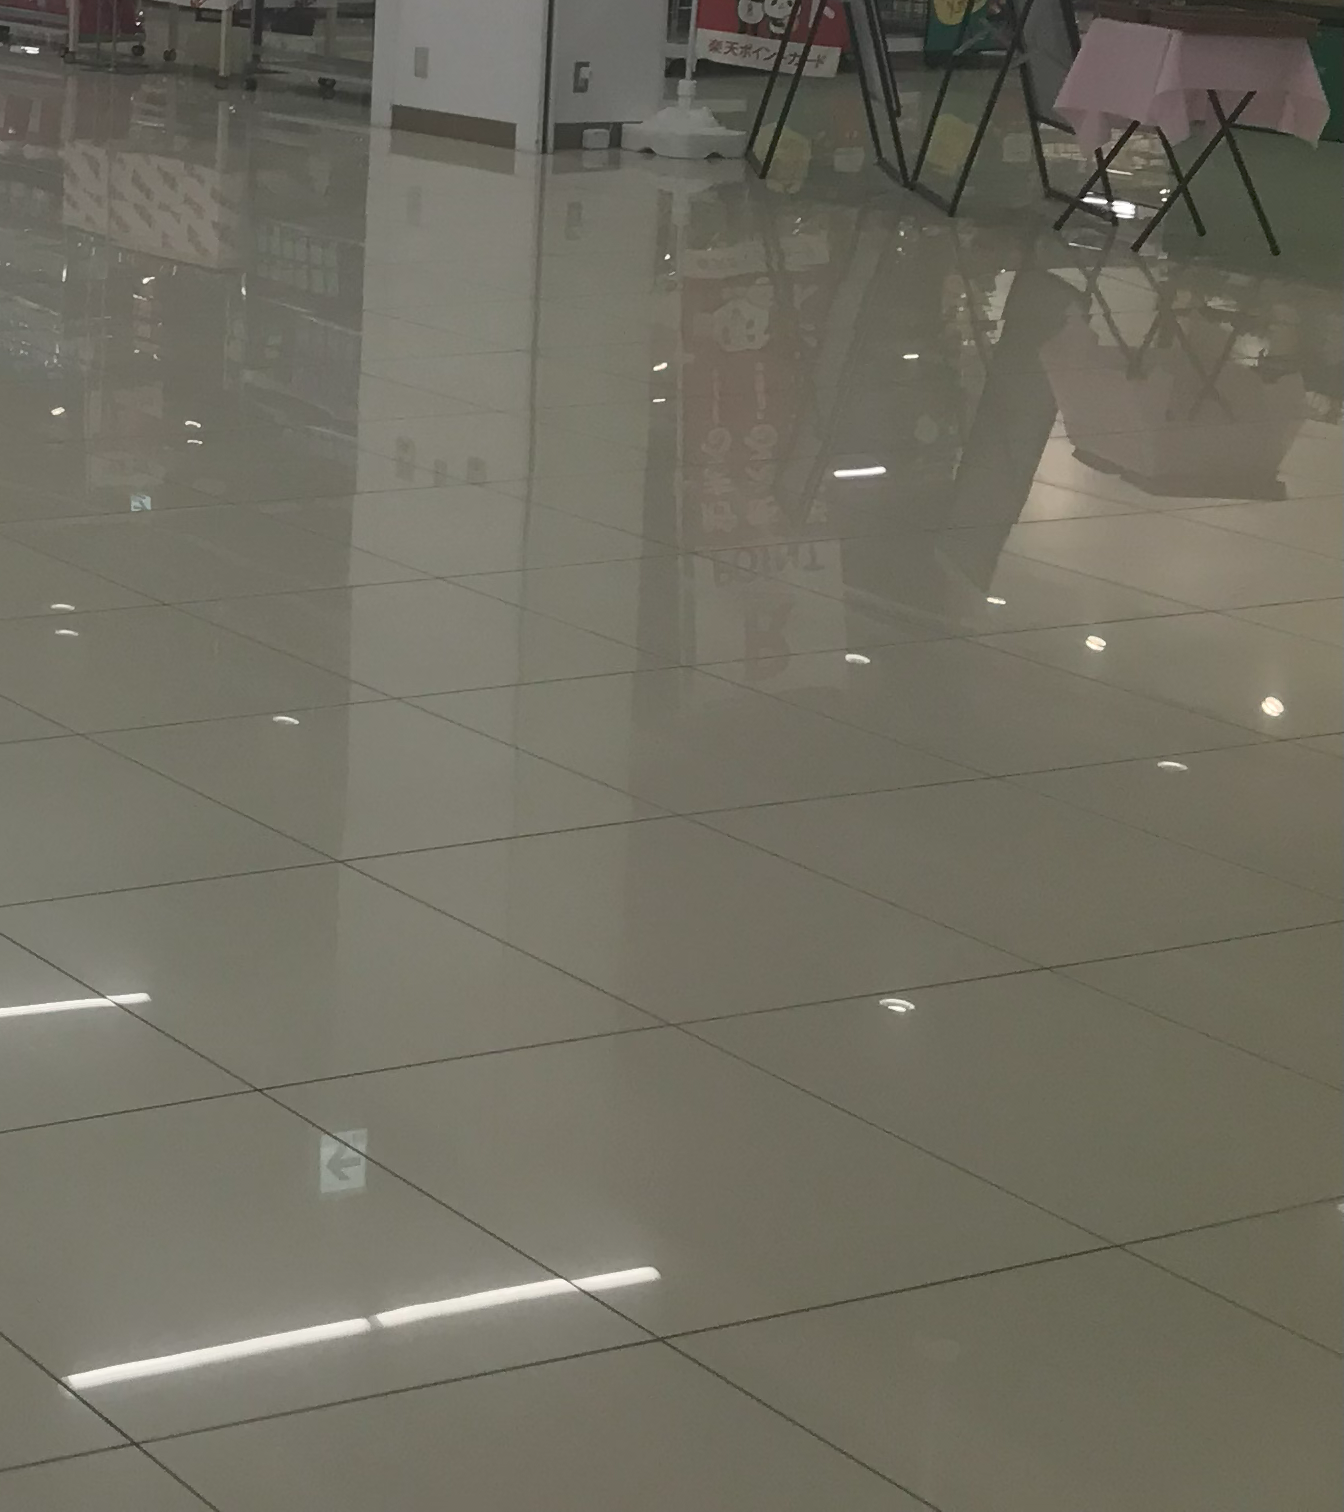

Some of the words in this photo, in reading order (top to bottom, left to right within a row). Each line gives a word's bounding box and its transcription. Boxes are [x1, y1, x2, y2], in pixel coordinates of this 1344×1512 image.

[708, 39, 827, 69] 楽天ポインカード
